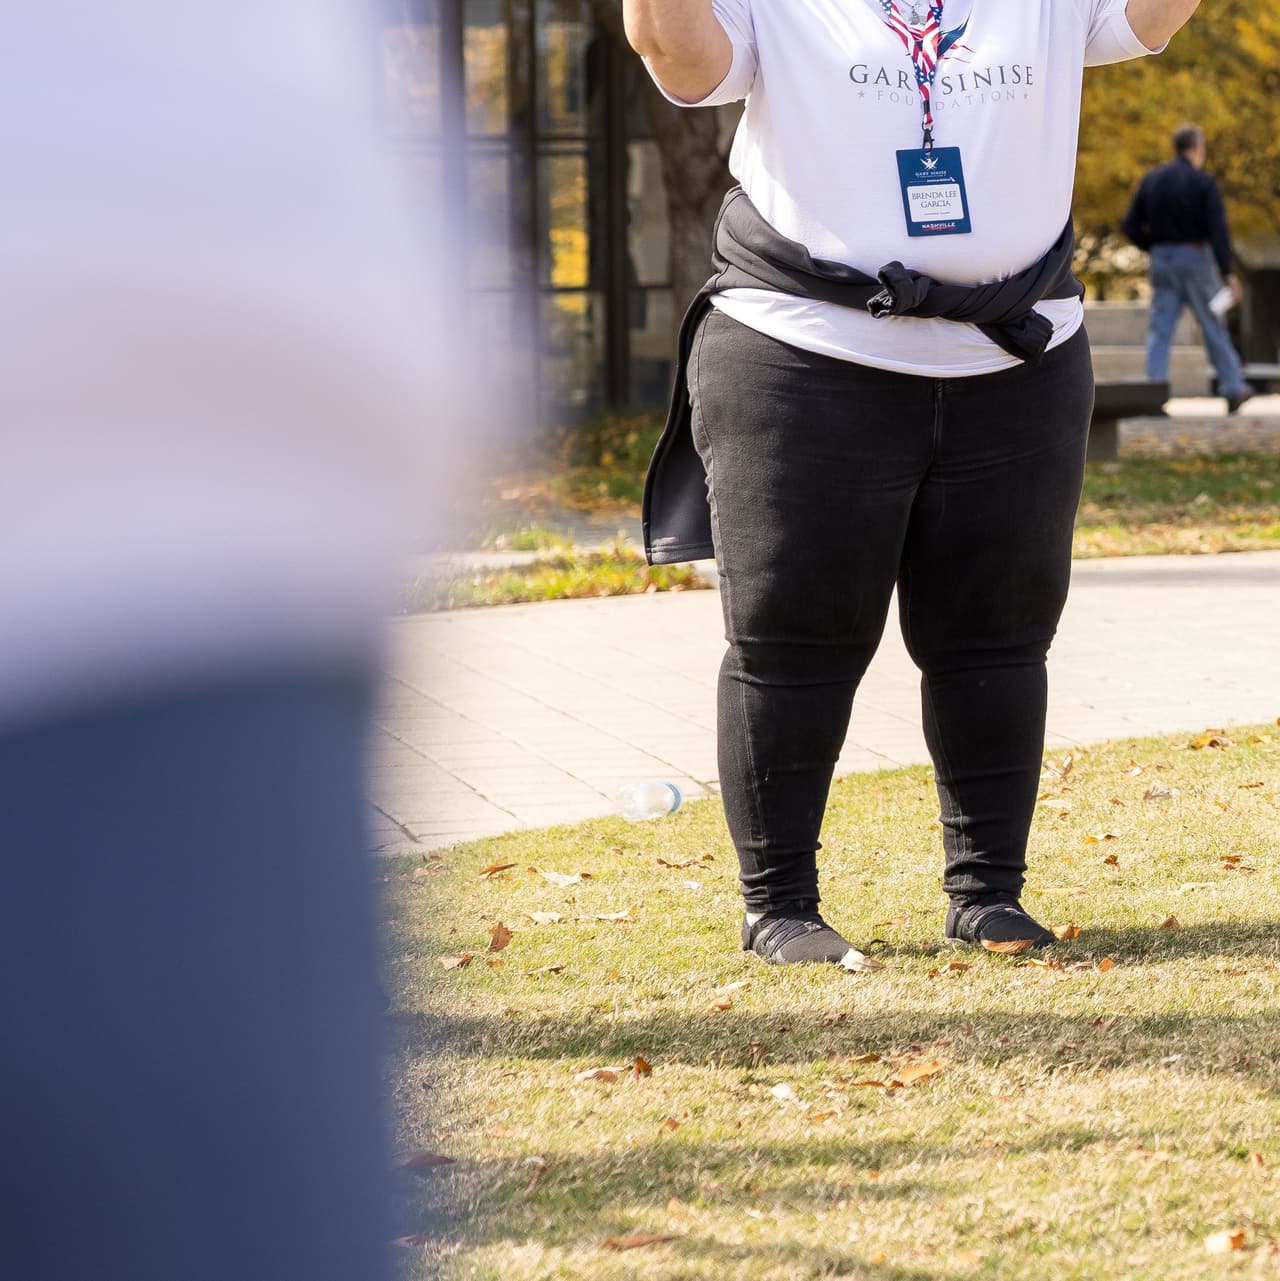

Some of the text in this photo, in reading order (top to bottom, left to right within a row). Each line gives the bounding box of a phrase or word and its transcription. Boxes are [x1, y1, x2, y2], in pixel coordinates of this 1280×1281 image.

[849, 64, 1033, 95] GAR SINISE
[876, 89, 1016, 111] FOUDATION
[912, 190, 957, 200] BRENDA LEE
[920, 200, 952, 208] GARCIA
